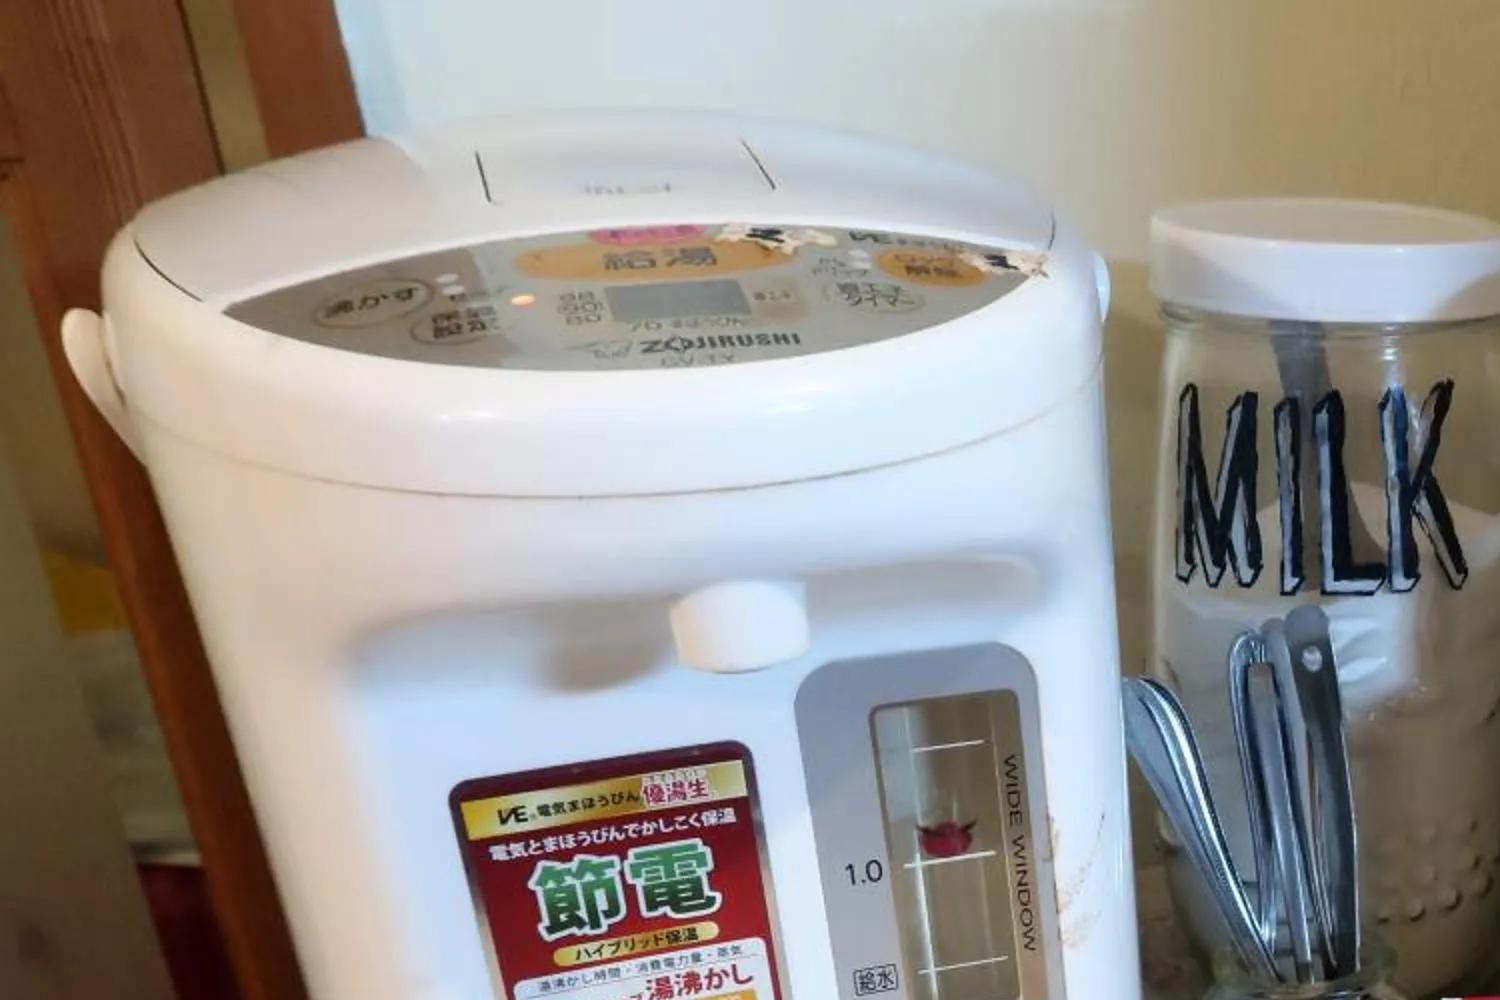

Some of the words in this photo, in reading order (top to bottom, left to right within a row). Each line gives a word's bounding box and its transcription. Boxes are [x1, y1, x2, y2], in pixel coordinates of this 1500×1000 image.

[639, 332, 802, 355] ZOJIRUSHI
[1175, 379, 1469, 596] MILK
[1003, 754, 1024, 828] WIDE
[488, 807, 738, 861] 電気とまほうびんでかしこく保温
[530, 838, 721, 941] 節電
[844, 859, 884, 887] 1.0
[1012, 835, 1038, 953] WINDOW
[575, 926, 702, 962] ハイブリッド保温
[857, 968, 895, 992] 給水
